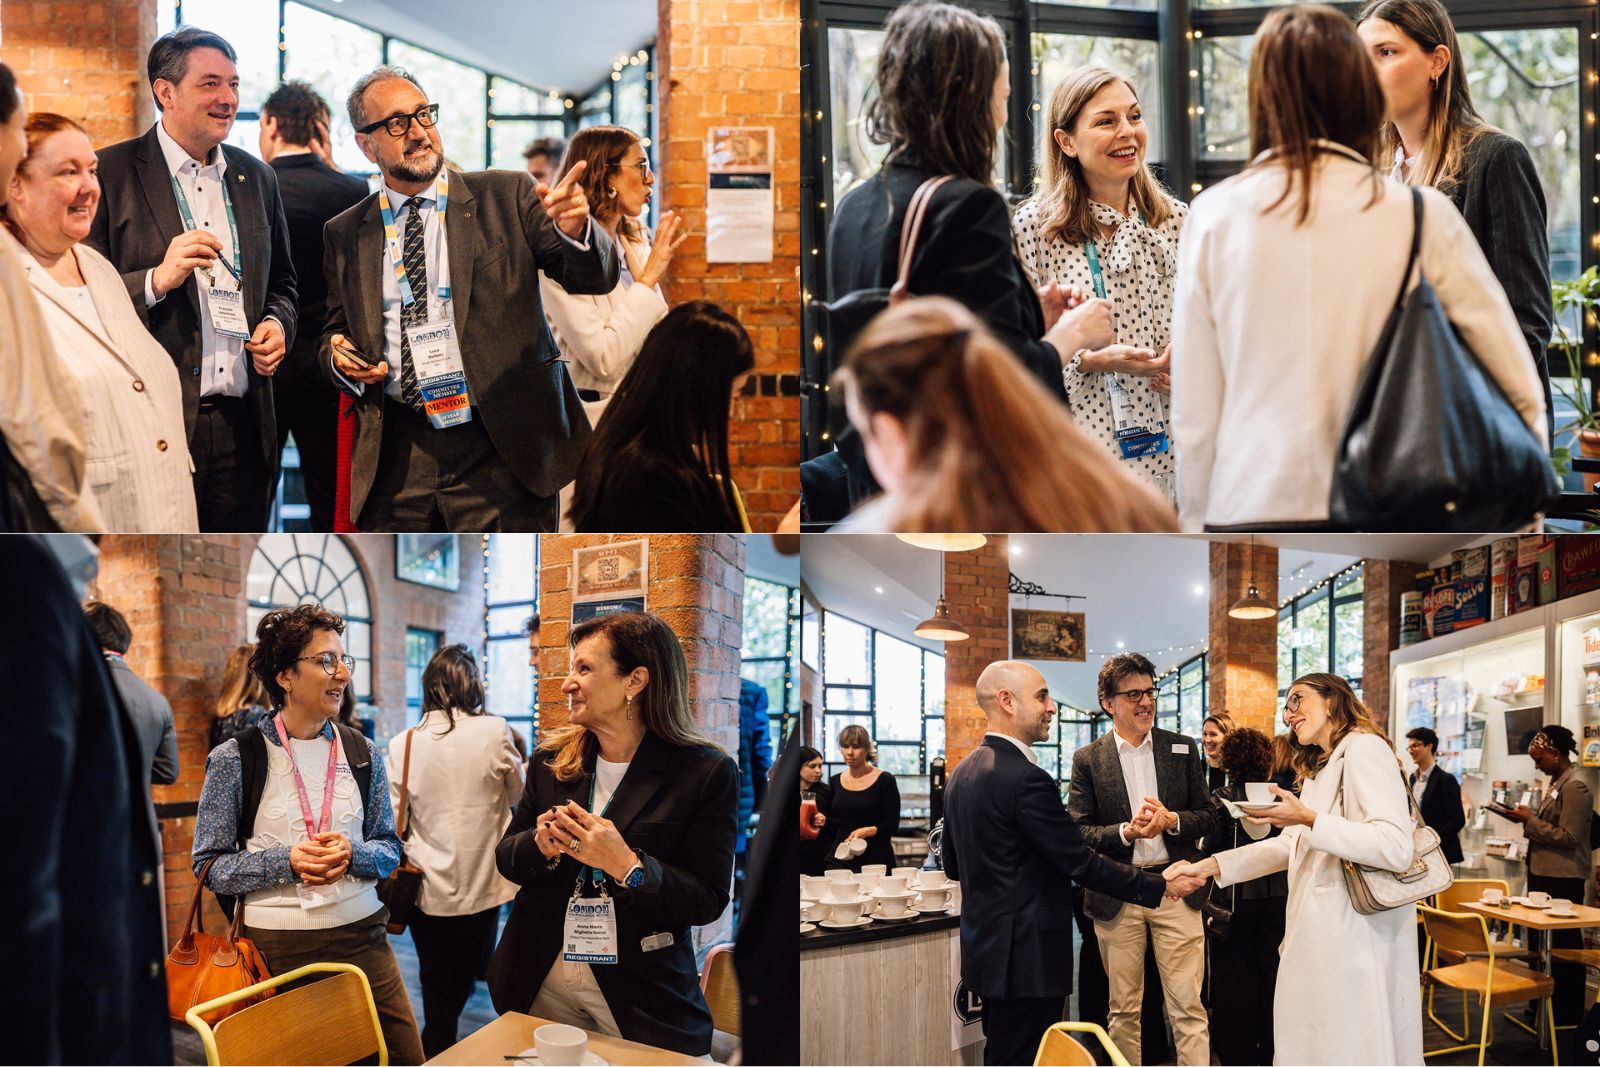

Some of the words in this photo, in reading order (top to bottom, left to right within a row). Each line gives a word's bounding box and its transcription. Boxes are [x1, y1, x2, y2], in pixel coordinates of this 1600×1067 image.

[208, 288, 240, 300] LONDON
[411, 329, 450, 342] LONDON
[428, 384, 460, 394] COMMITTEE
[433, 390, 457, 398] MEMBER
[428, 397, 466, 411] MENTOR
[1455, 582, 1484, 610] SOLVO
[568, 904, 609, 914] LONDON
